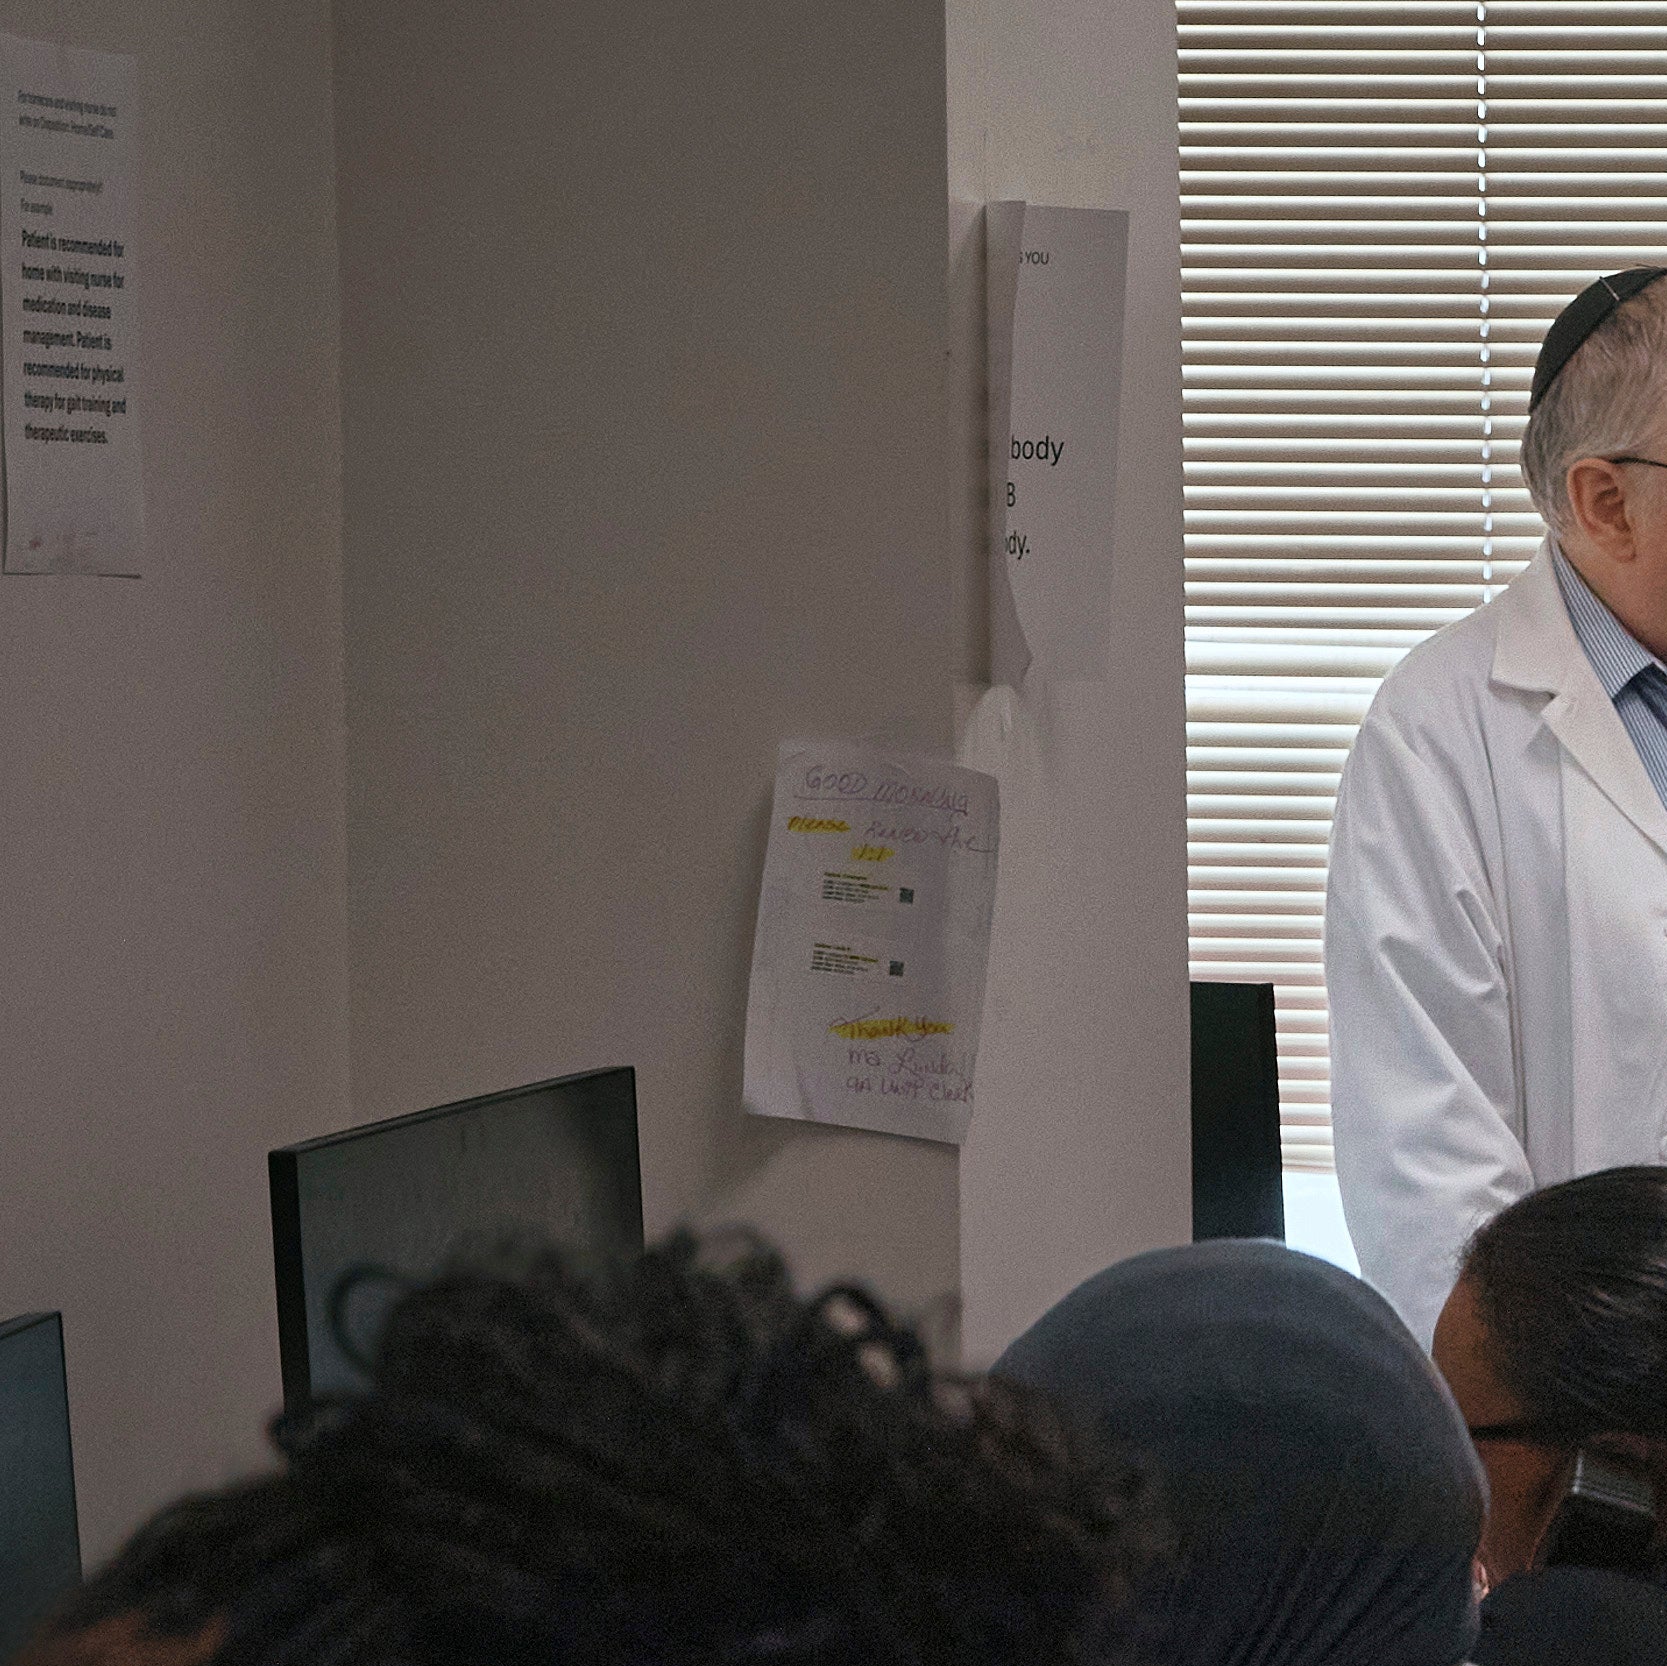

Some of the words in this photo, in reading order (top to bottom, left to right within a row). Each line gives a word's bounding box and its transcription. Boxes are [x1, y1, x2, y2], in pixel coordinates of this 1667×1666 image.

[22, 229, 49, 249] Patient
[58, 237, 112, 256] recommended
[113, 240, 124, 257] for
[1025, 251, 1049, 265] YOU
[22, 262, 45, 280] home
[46, 265, 62, 283] with
[64, 267, 89, 289] visiting
[90, 273, 112, 288] nurse
[113, 271, 124, 288] for
[22, 295, 66, 315] medication
[67, 299, 81, 316] and
[82, 301, 111, 319] disease
[76, 331, 103, 350] Patient
[24, 361, 79, 379] recommended
[80, 362, 91, 380] for
[92, 364, 125, 384] physical
[24, 391, 53, 412] therapy
[54, 392, 65, 410] for
[66, 394, 81, 415] gait
[82, 396, 111, 418] training
[112, 397, 126, 415] and
[25, 423, 69, 443] therapeutic
[70, 426, 109, 444] exercises.
[1011, 434, 1065, 466] body
[805, 764, 868, 794] GOOD
